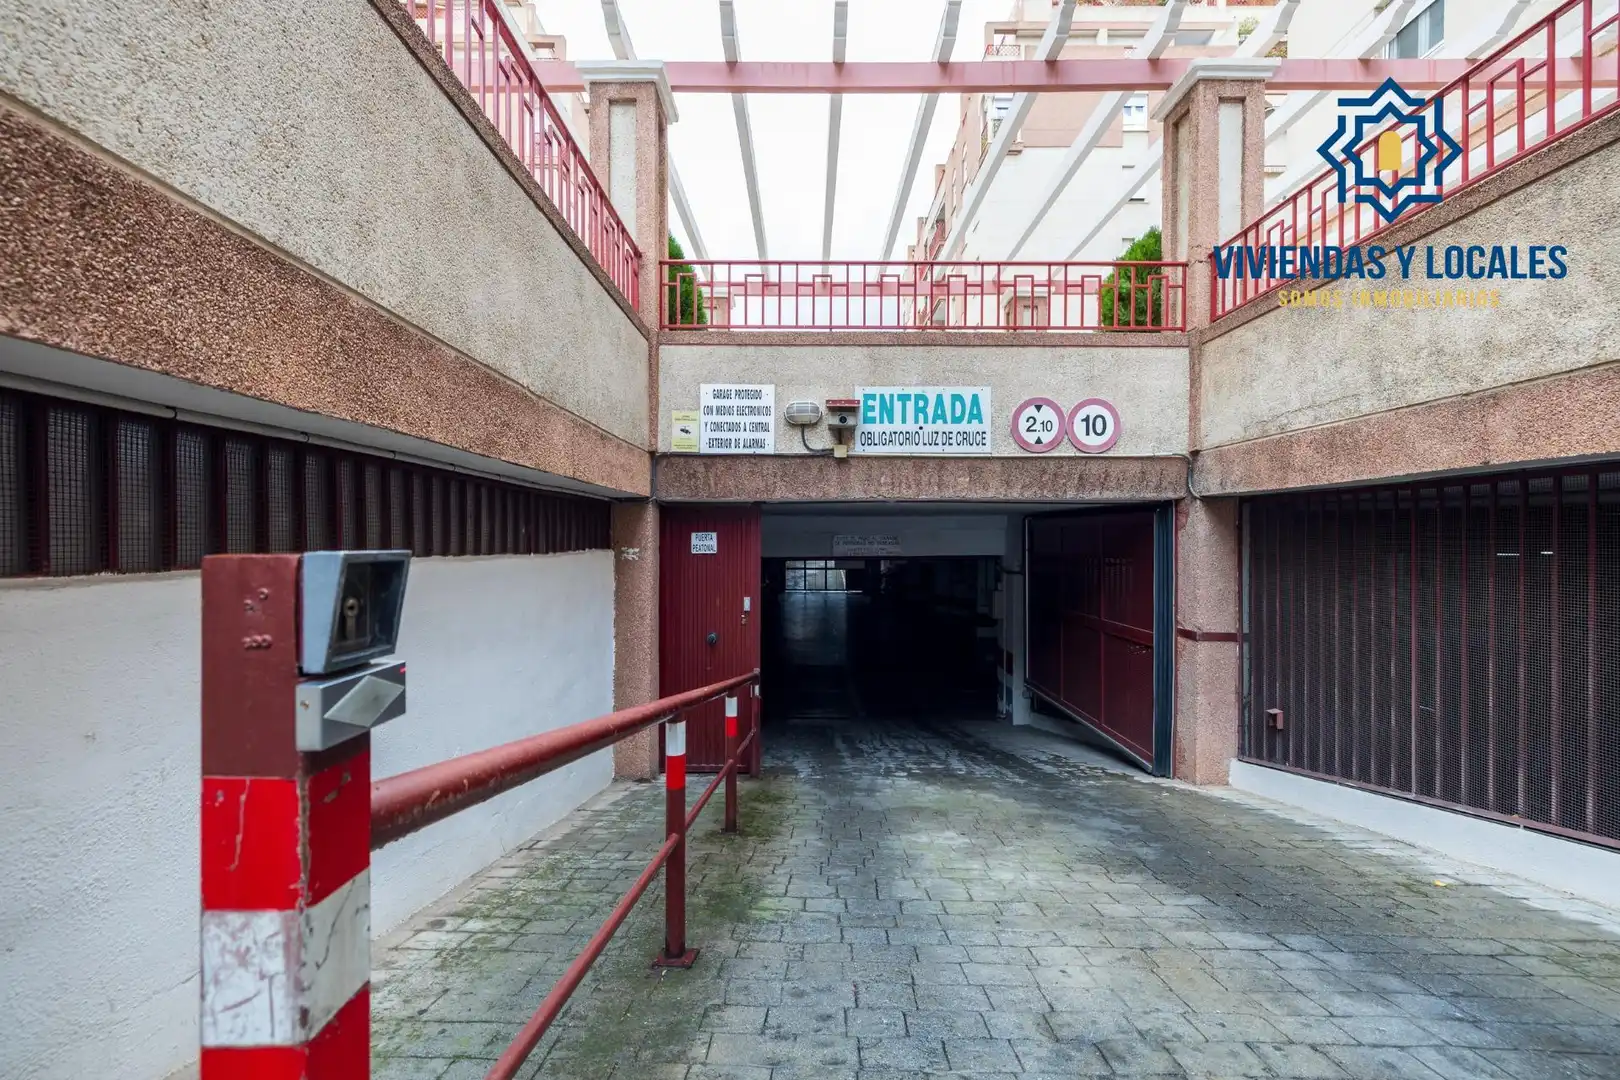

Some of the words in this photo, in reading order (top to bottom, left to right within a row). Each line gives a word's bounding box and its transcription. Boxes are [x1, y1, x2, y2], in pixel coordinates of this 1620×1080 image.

[712, 388, 733, 400] GARAGE
[734, 388, 763, 400] PROTEGIDO
[703, 405, 714, 416] CON
[715, 405, 735, 416] MEDIOS
[736, 405, 772, 417] ELECTRONICOS
[862, 393, 984, 425] ENTRADA
[704, 421, 709, 433] Y
[710, 421, 742, 433] CONECTADOS
[743, 421, 748, 433] A
[748, 421, 770, 433] CENTRAL
[1025, 416, 1053, 433] 2.10
[1080, 414, 1107, 437] 10
[708, 438, 732, 449] EXTERIOR
[734, 438, 741, 449] DE
[743, 438, 766, 449] ALARMAS
[860, 431, 921, 446] OBLIGATORIO
[922, 431, 940, 446] LUZ
[941, 431, 954, 446] DE
[955, 431, 987, 446] CRUCE
[695, 533, 714, 542] PUERTA
[692, 543, 716, 552] PEATONAL
